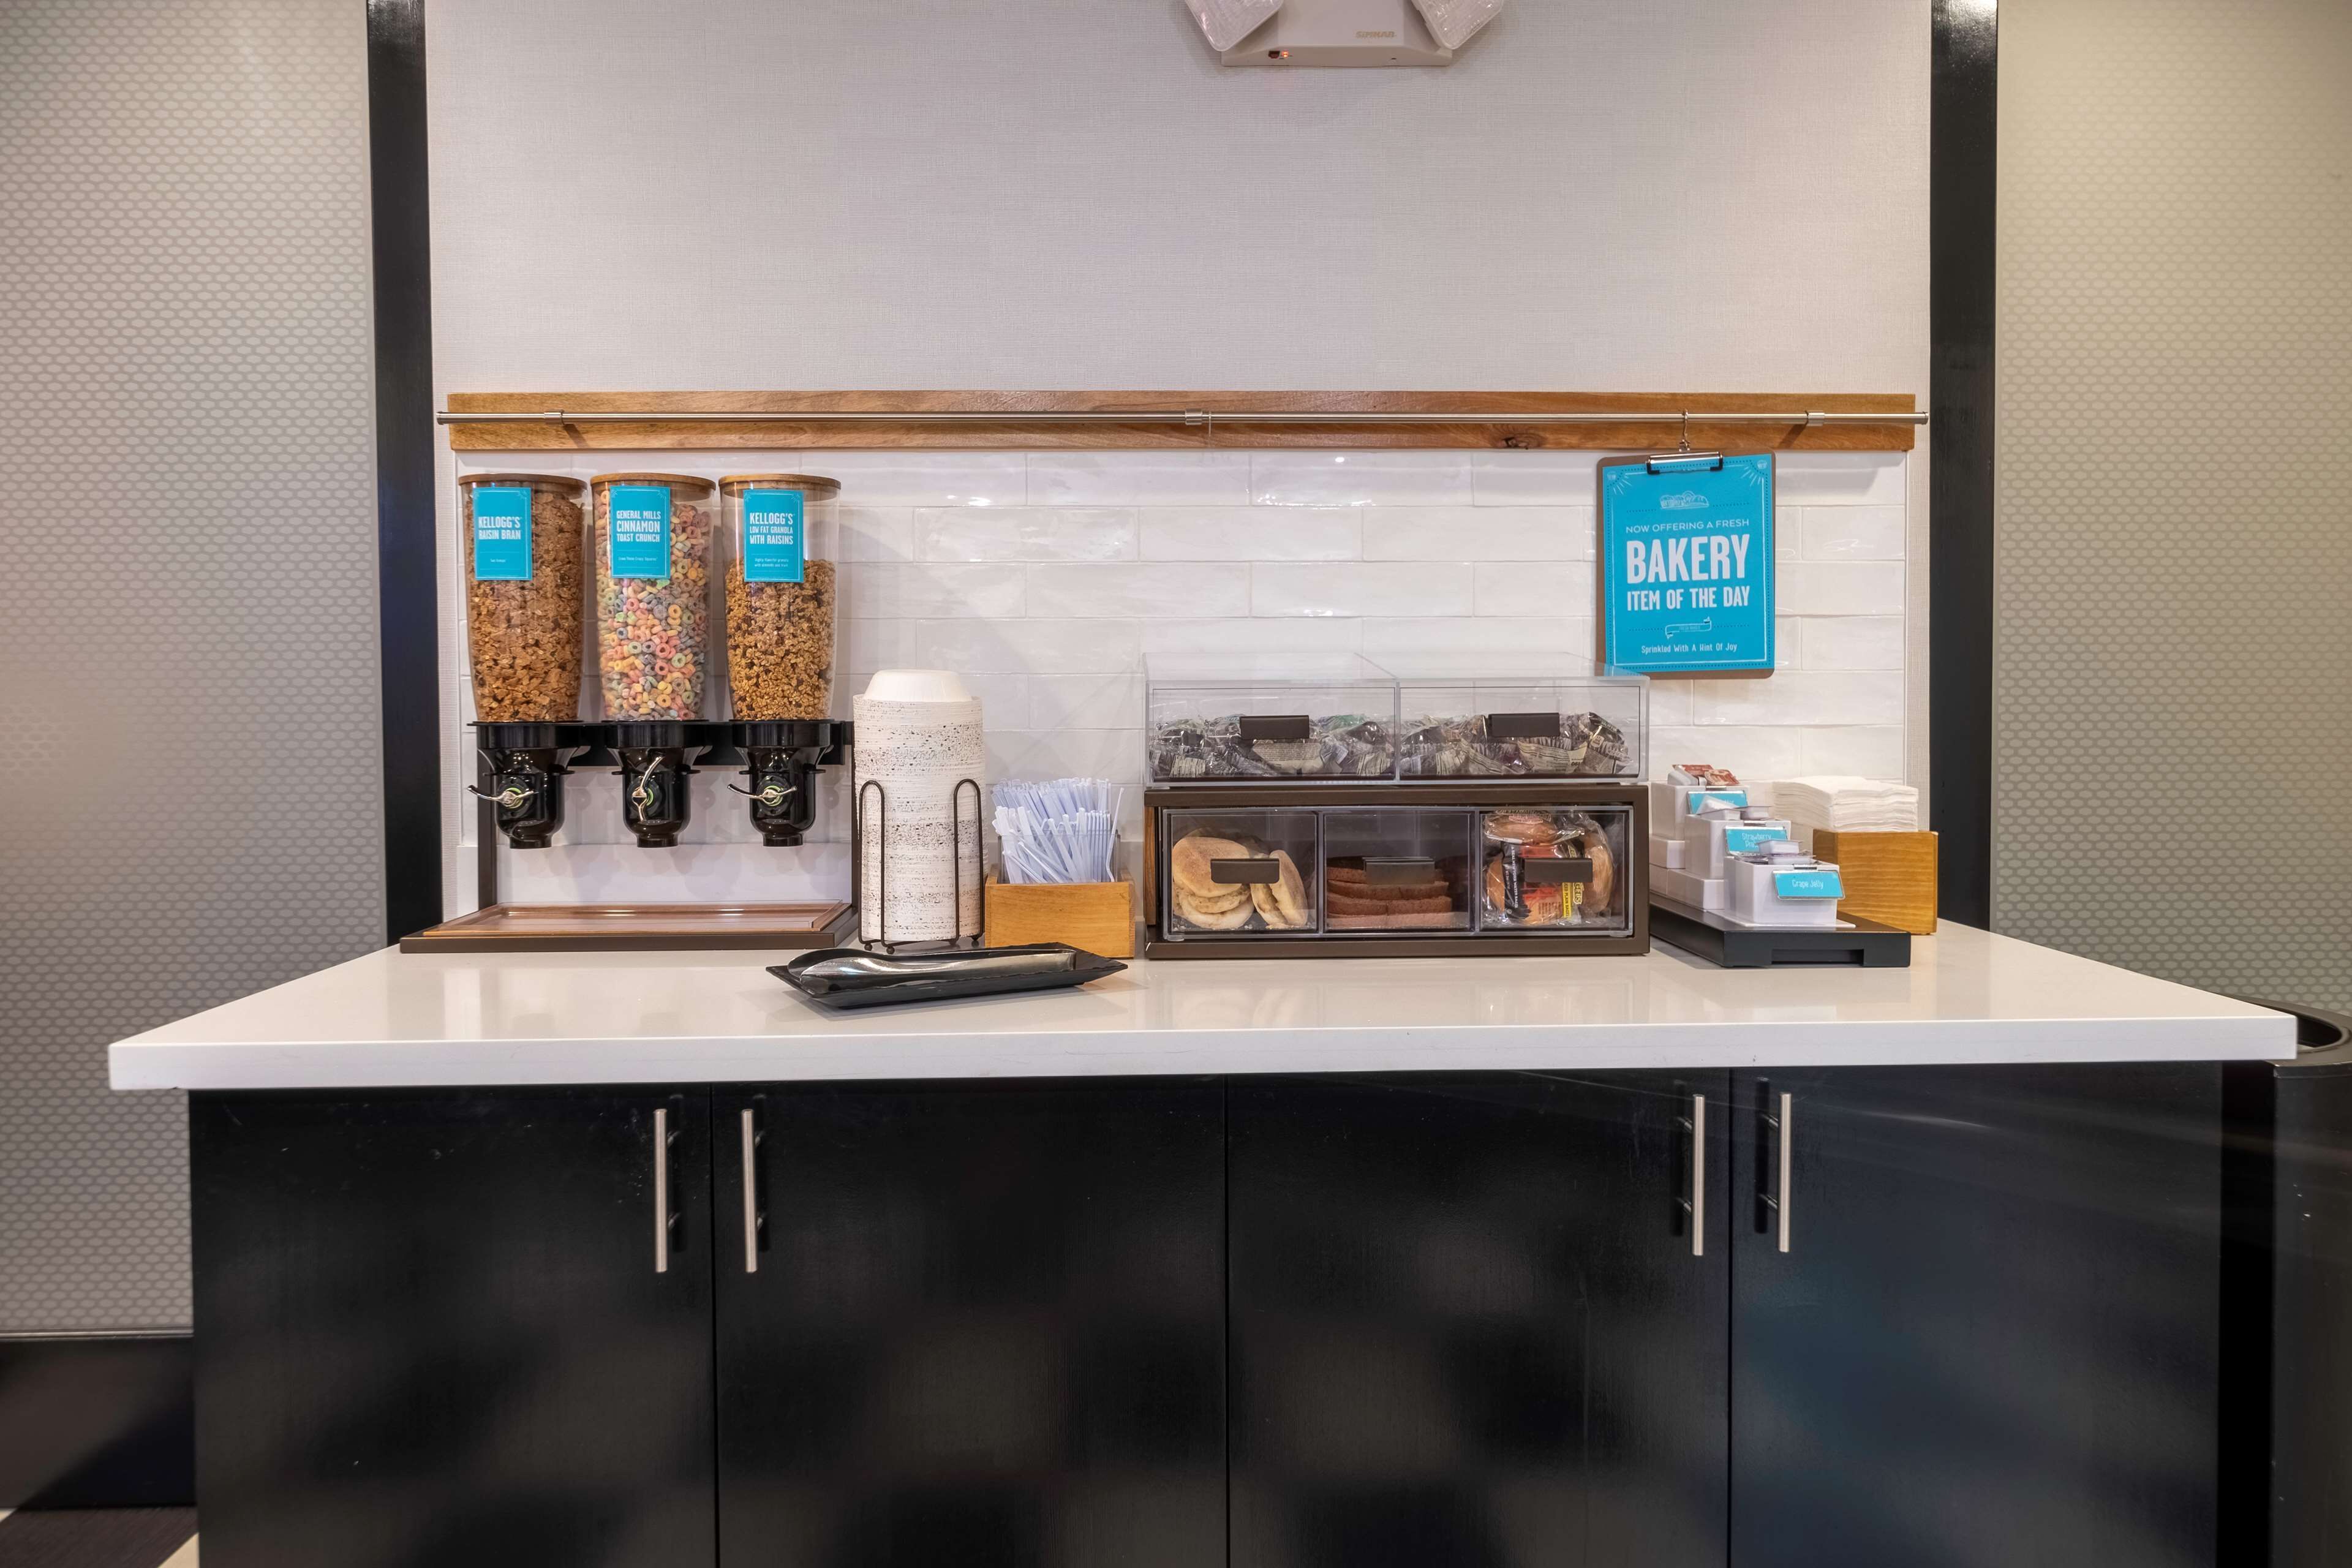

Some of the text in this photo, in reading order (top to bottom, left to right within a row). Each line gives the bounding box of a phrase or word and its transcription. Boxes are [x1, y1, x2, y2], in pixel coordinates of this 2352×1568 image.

[617, 510, 661, 519] GENERAL MILLS
[750, 513, 793, 524] KELLOGG'S
[478, 516, 521, 528] KELLOGG'S
[617, 521, 660, 532] CINNAMON
[1653, 521, 1704, 532] OFFERING
[1716, 519, 1749, 528] FRESH
[479, 530, 521, 540] RAISIN BRAN
[617, 533, 660, 542] TOAST CRUNCH
[750, 535, 793, 545] WITH RAISINS
[1626, 534, 1750, 584] BAKERY
[1627, 586, 1750, 611] ITEM OF THE DAY
[1725, 643, 1737, 652] Joy
[1792, 880, 1823, 889] Grape Jelly
